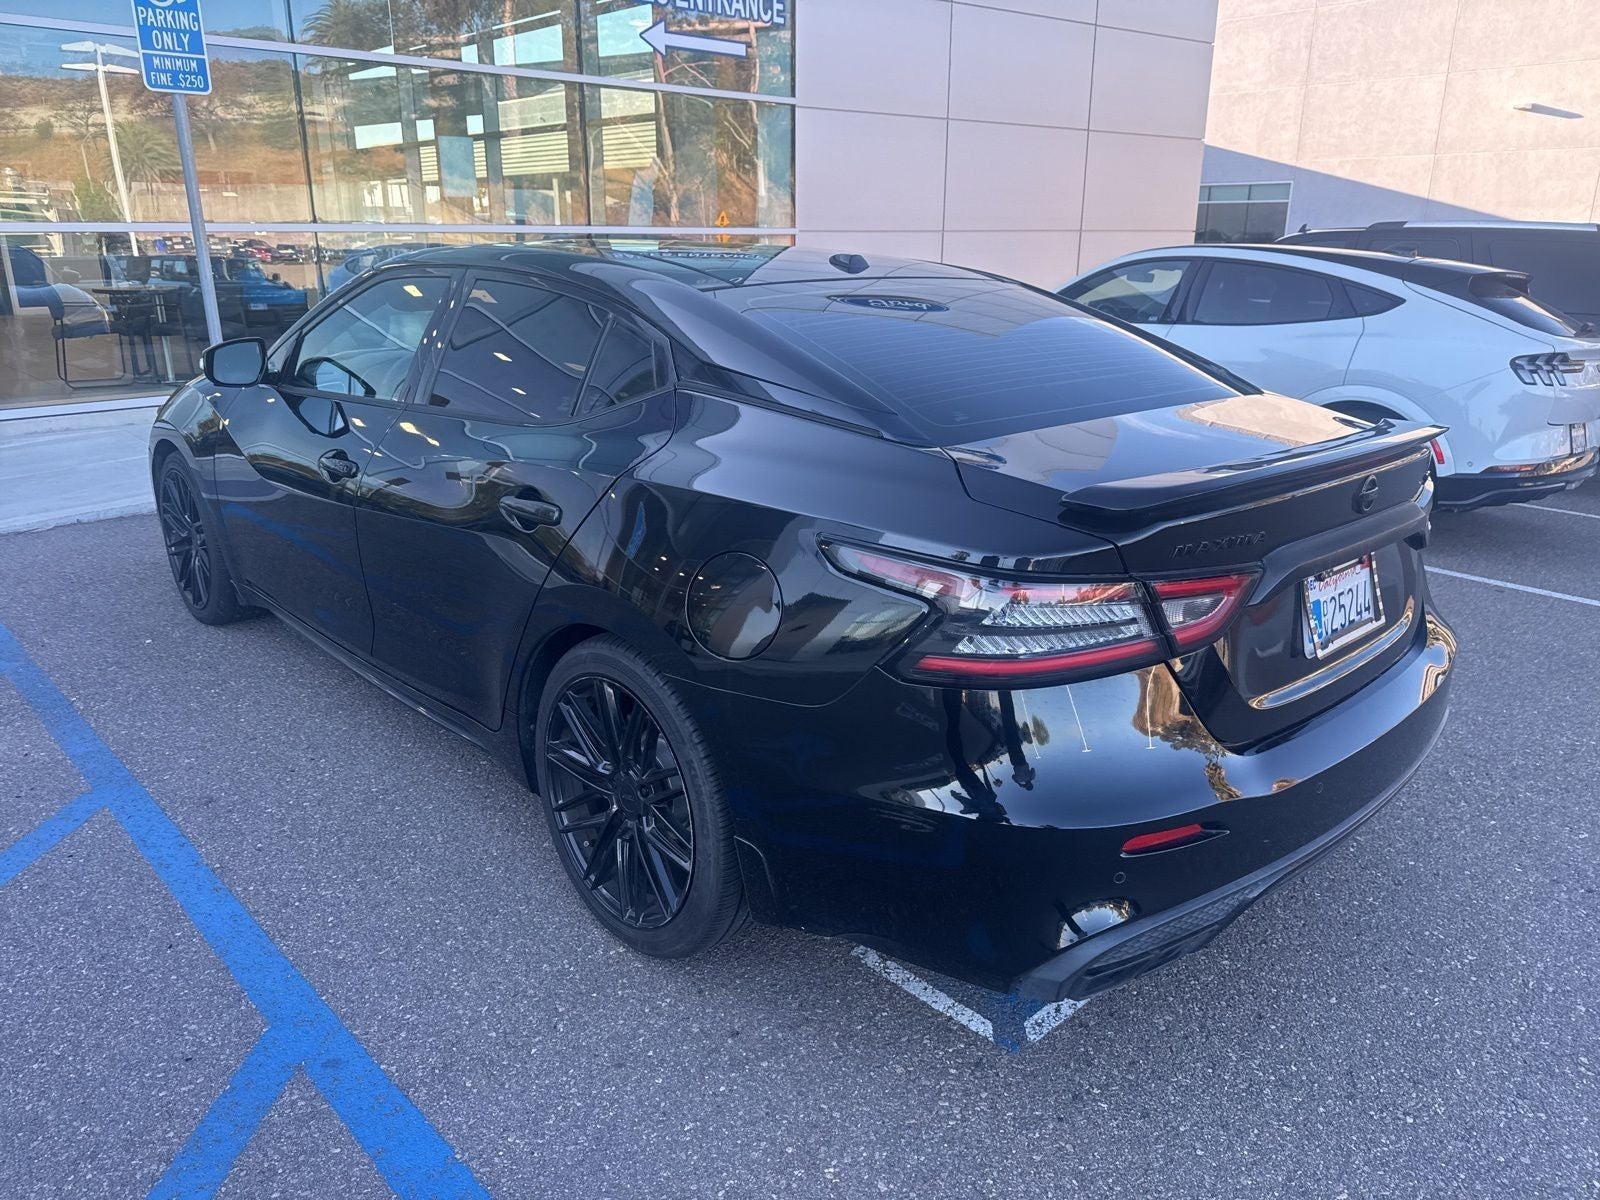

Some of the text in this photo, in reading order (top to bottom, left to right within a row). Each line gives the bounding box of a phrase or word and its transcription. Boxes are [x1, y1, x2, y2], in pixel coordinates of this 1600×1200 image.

[137, 7, 199, 31] PARKING
[675, 0, 785, 24] RANCE
[152, 30, 190, 51] ONLY
[152, 56, 198, 72] MINIMUM
[151, 72, 204, 88] FINE $250
